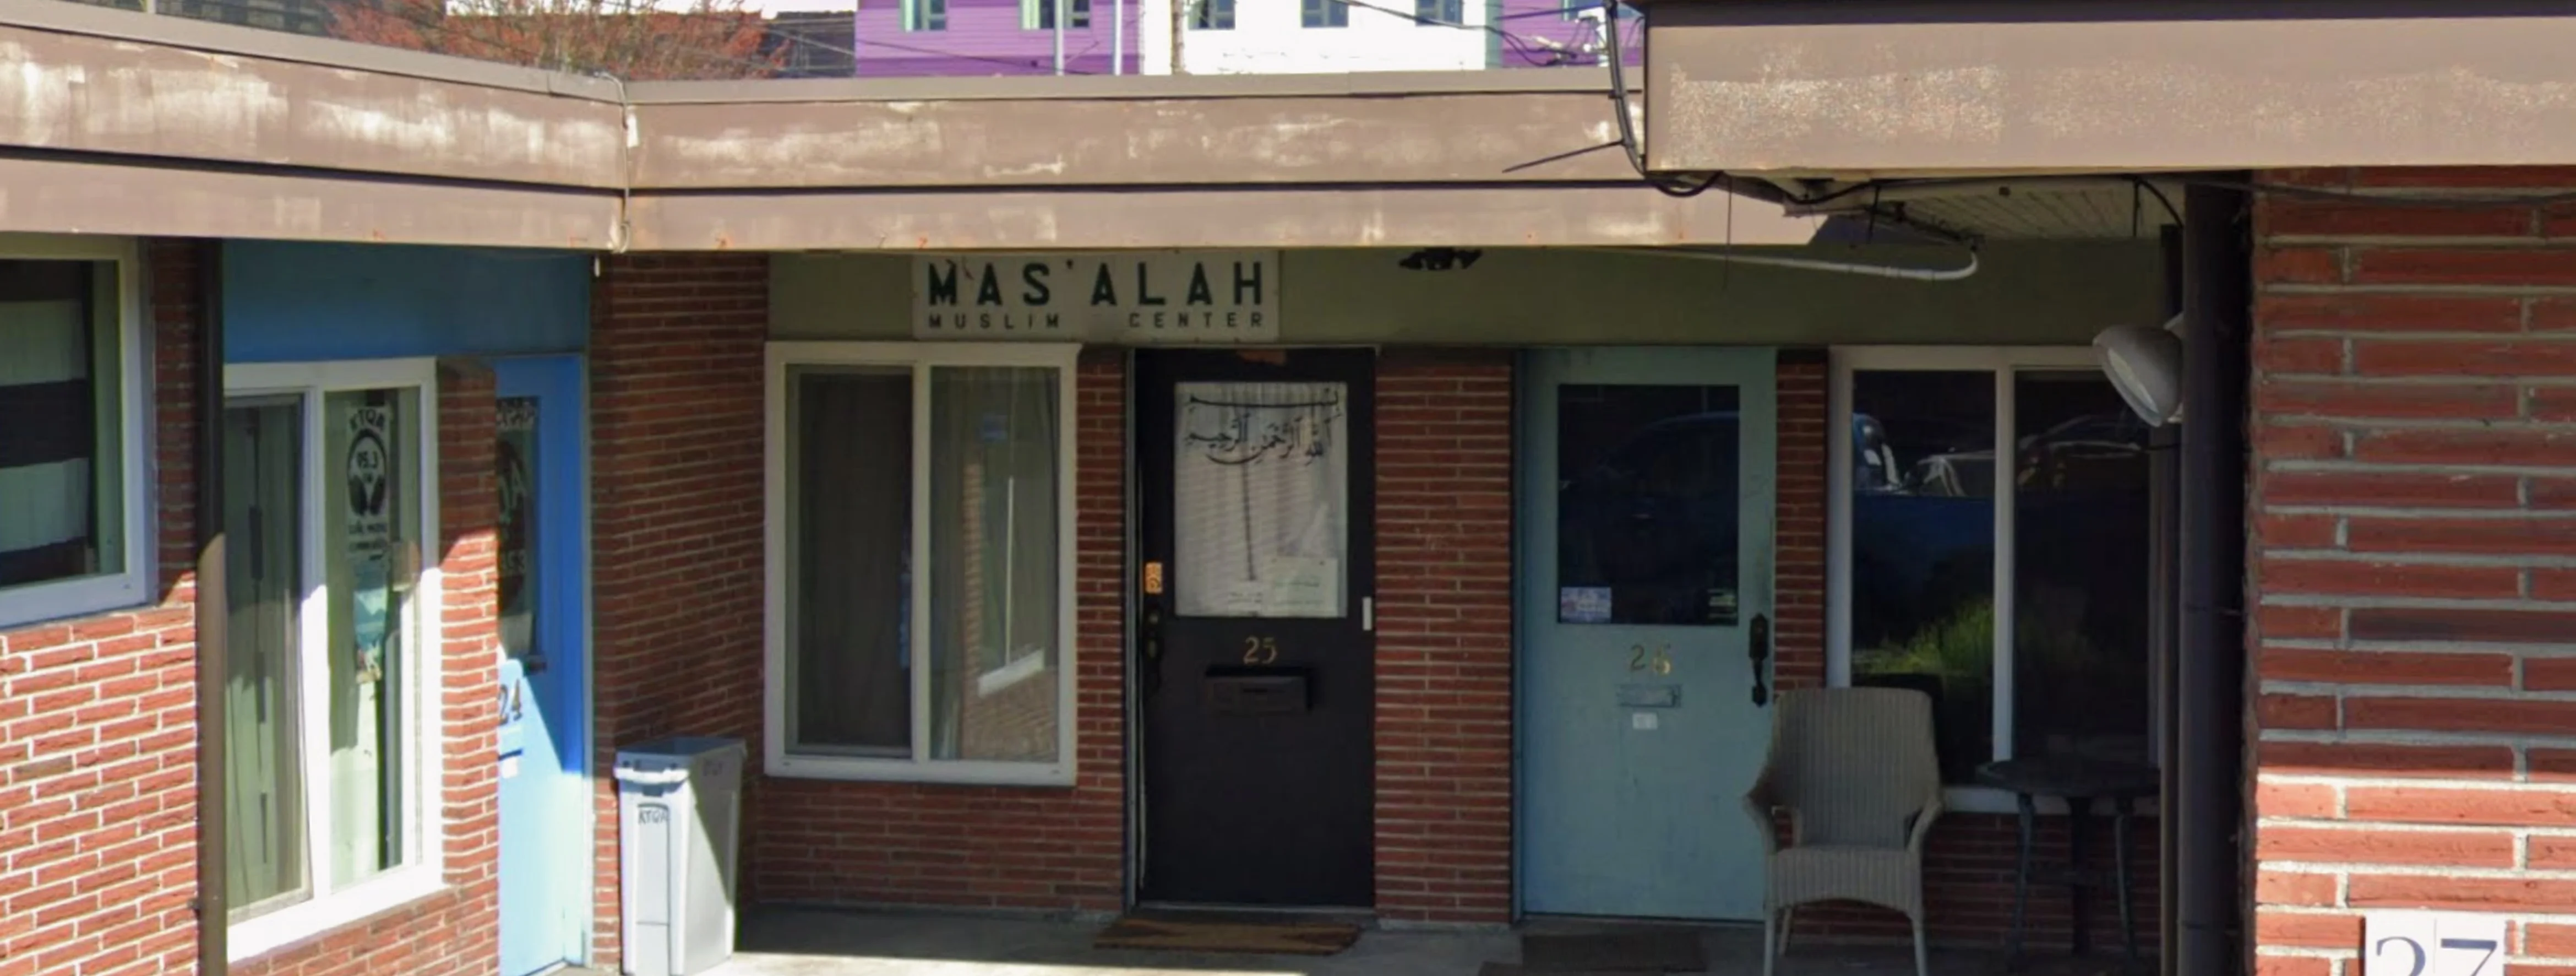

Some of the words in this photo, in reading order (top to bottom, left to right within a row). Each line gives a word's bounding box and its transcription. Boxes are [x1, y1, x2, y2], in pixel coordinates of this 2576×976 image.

[929, 313, 1059, 328] MUSLIM
[1129, 312, 1263, 328] CENTER
[1243, 636, 1277, 663] 25
[1630, 643, 1673, 675] 26
